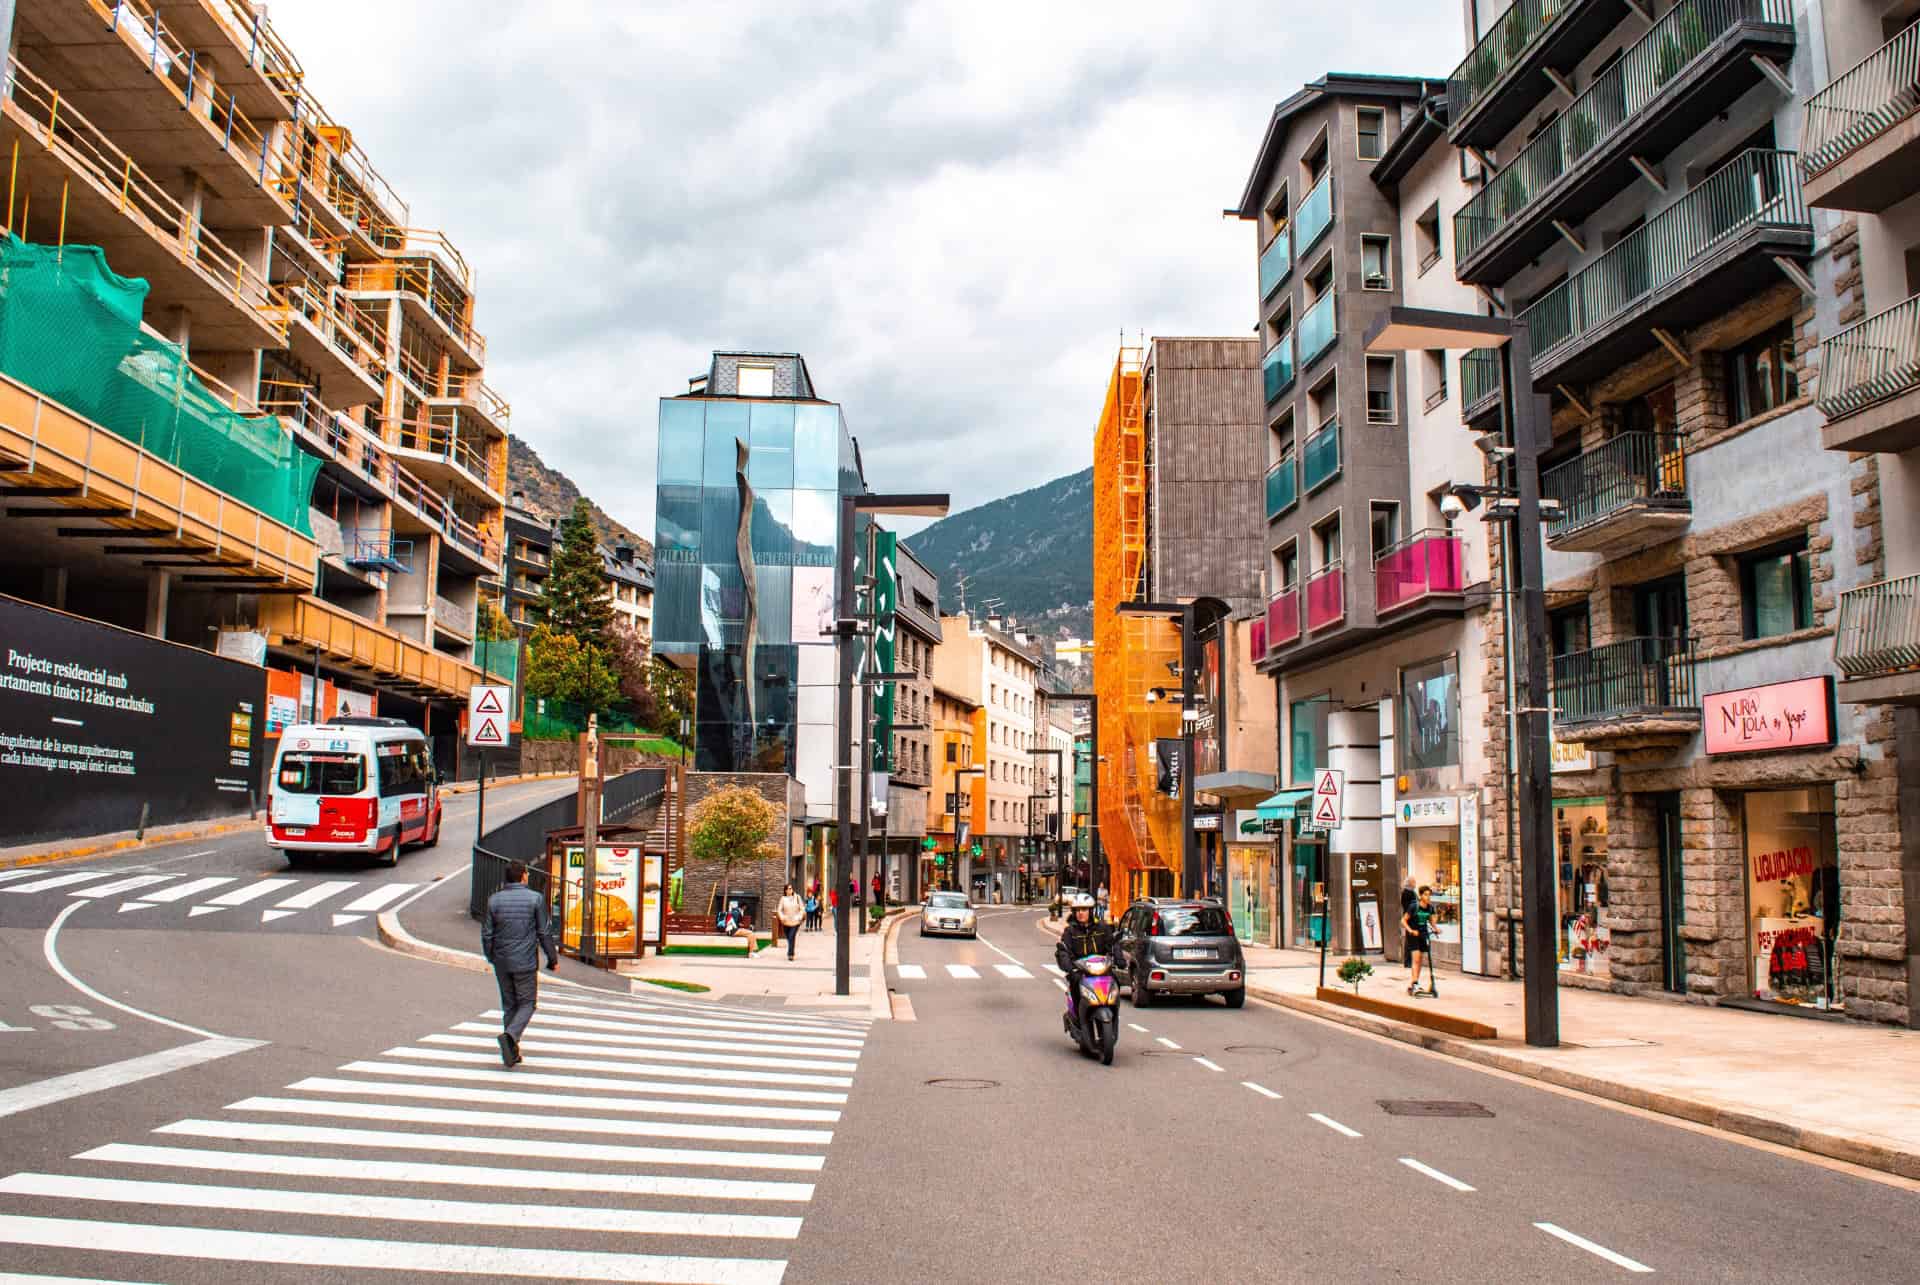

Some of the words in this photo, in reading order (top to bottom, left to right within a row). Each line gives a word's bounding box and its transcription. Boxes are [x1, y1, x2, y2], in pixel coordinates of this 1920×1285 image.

[8, 649, 53, 675] Projecte
[54, 663, 107, 685] residencial
[107, 673, 128, 689] amb
[53, 681, 80, 701] únics
[86, 687, 94, 703] 2
[115, 695, 155, 714] exclusius
[0, 732, 42, 750] ingularitat
